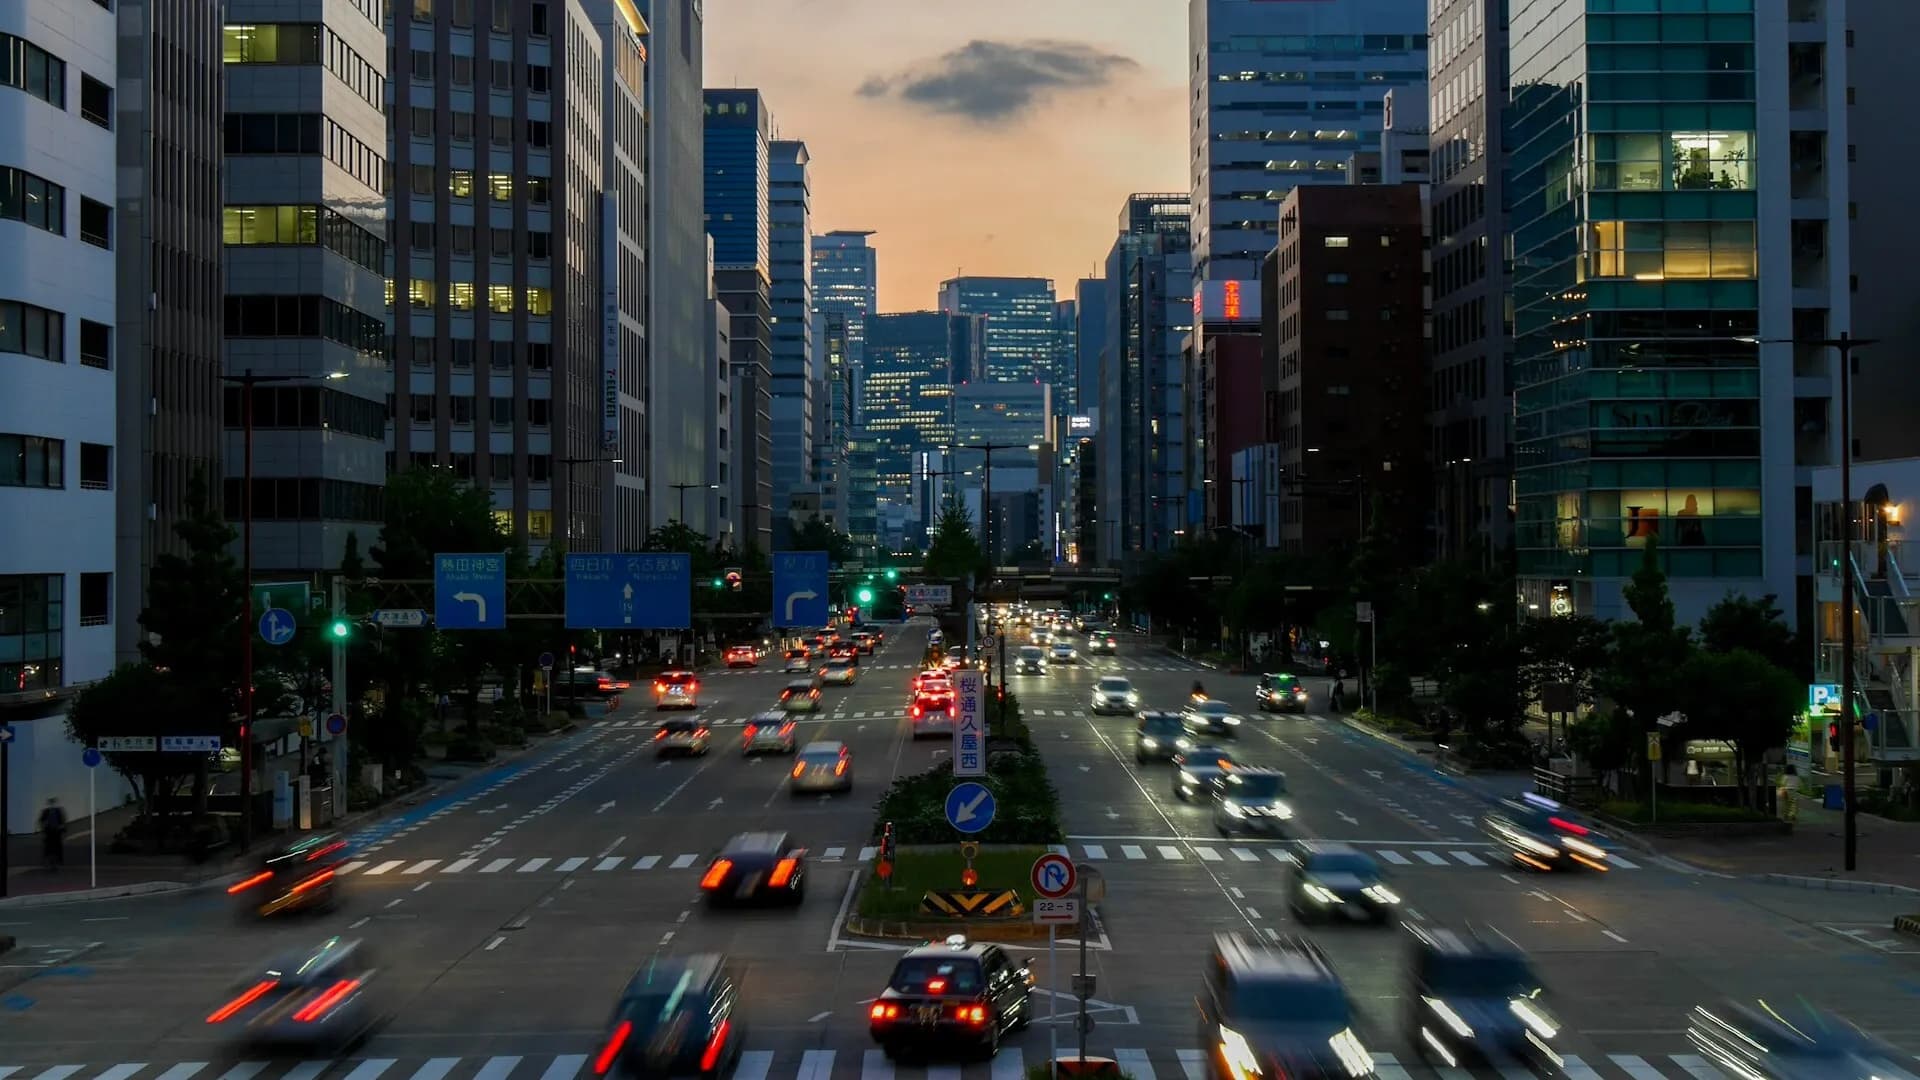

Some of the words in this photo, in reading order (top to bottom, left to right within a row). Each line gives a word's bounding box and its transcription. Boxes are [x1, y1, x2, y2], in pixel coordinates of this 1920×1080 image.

[441, 558, 498, 572] 熱田神宮
[571, 558, 614, 572] 四日市
[1814, 686, 1828, 704] P
[960, 677, 978, 769] 桜通久屋西
[1039, 902, 1074, 911] 22-5
